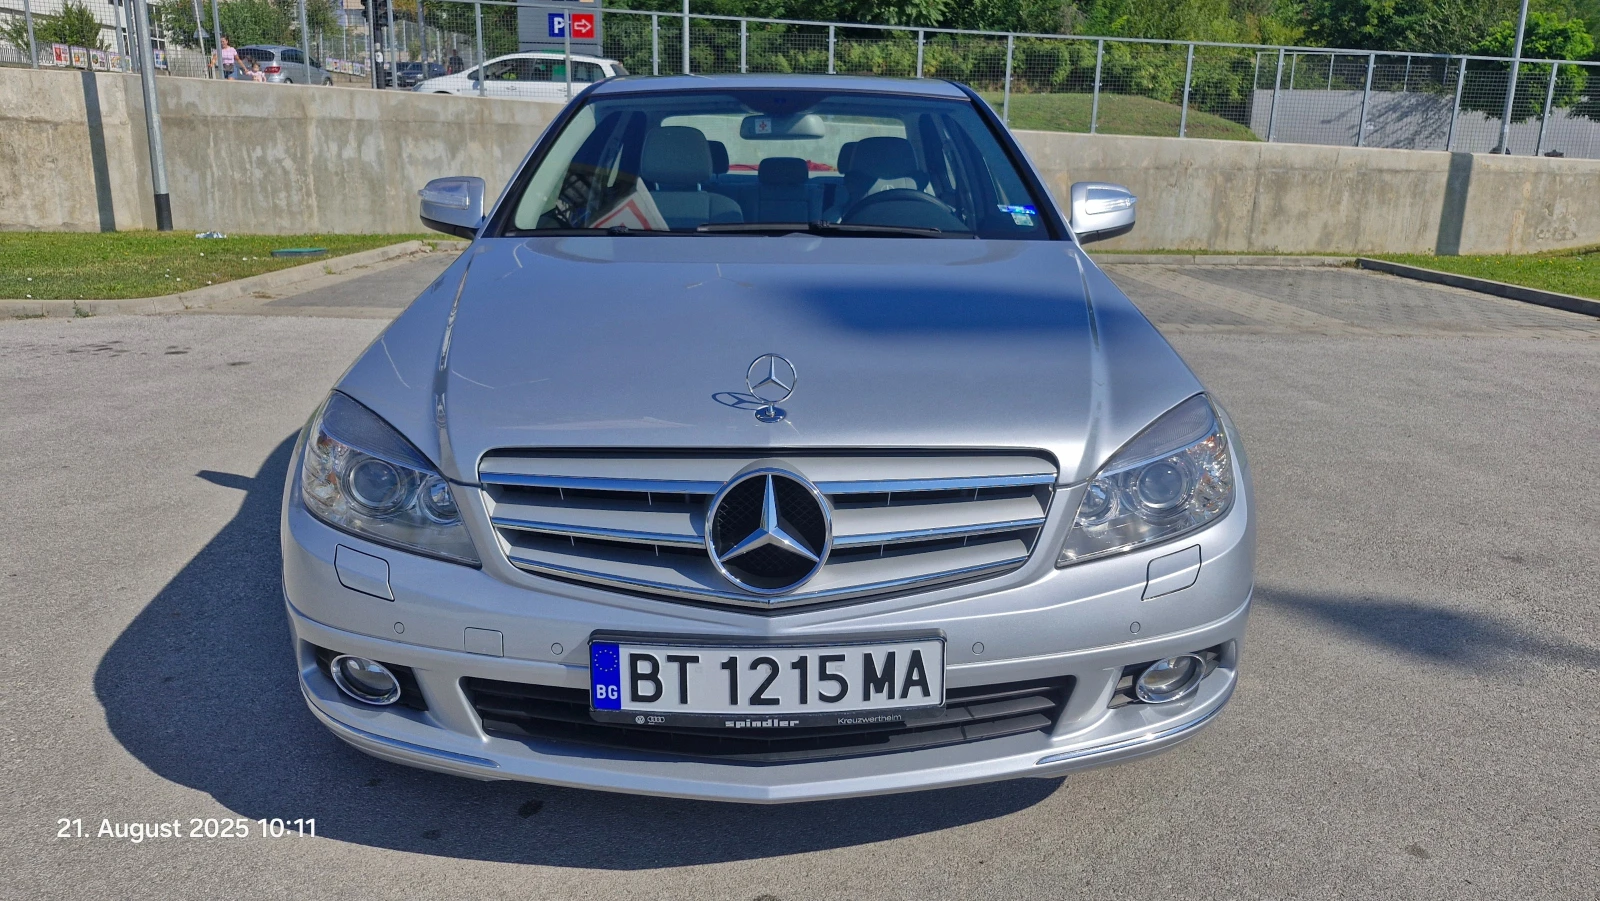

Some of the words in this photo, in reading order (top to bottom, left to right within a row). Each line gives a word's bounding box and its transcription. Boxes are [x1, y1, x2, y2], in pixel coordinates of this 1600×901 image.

[553, 17, 565, 34] P
[628, 653, 700, 705] BT
[720, 654, 849, 706] 1215
[862, 649, 931, 702] MA
[596, 684, 618, 700] BG
[725, 718, 799, 729] spindler
[837, 713, 902, 725] Kreuzwertheim
